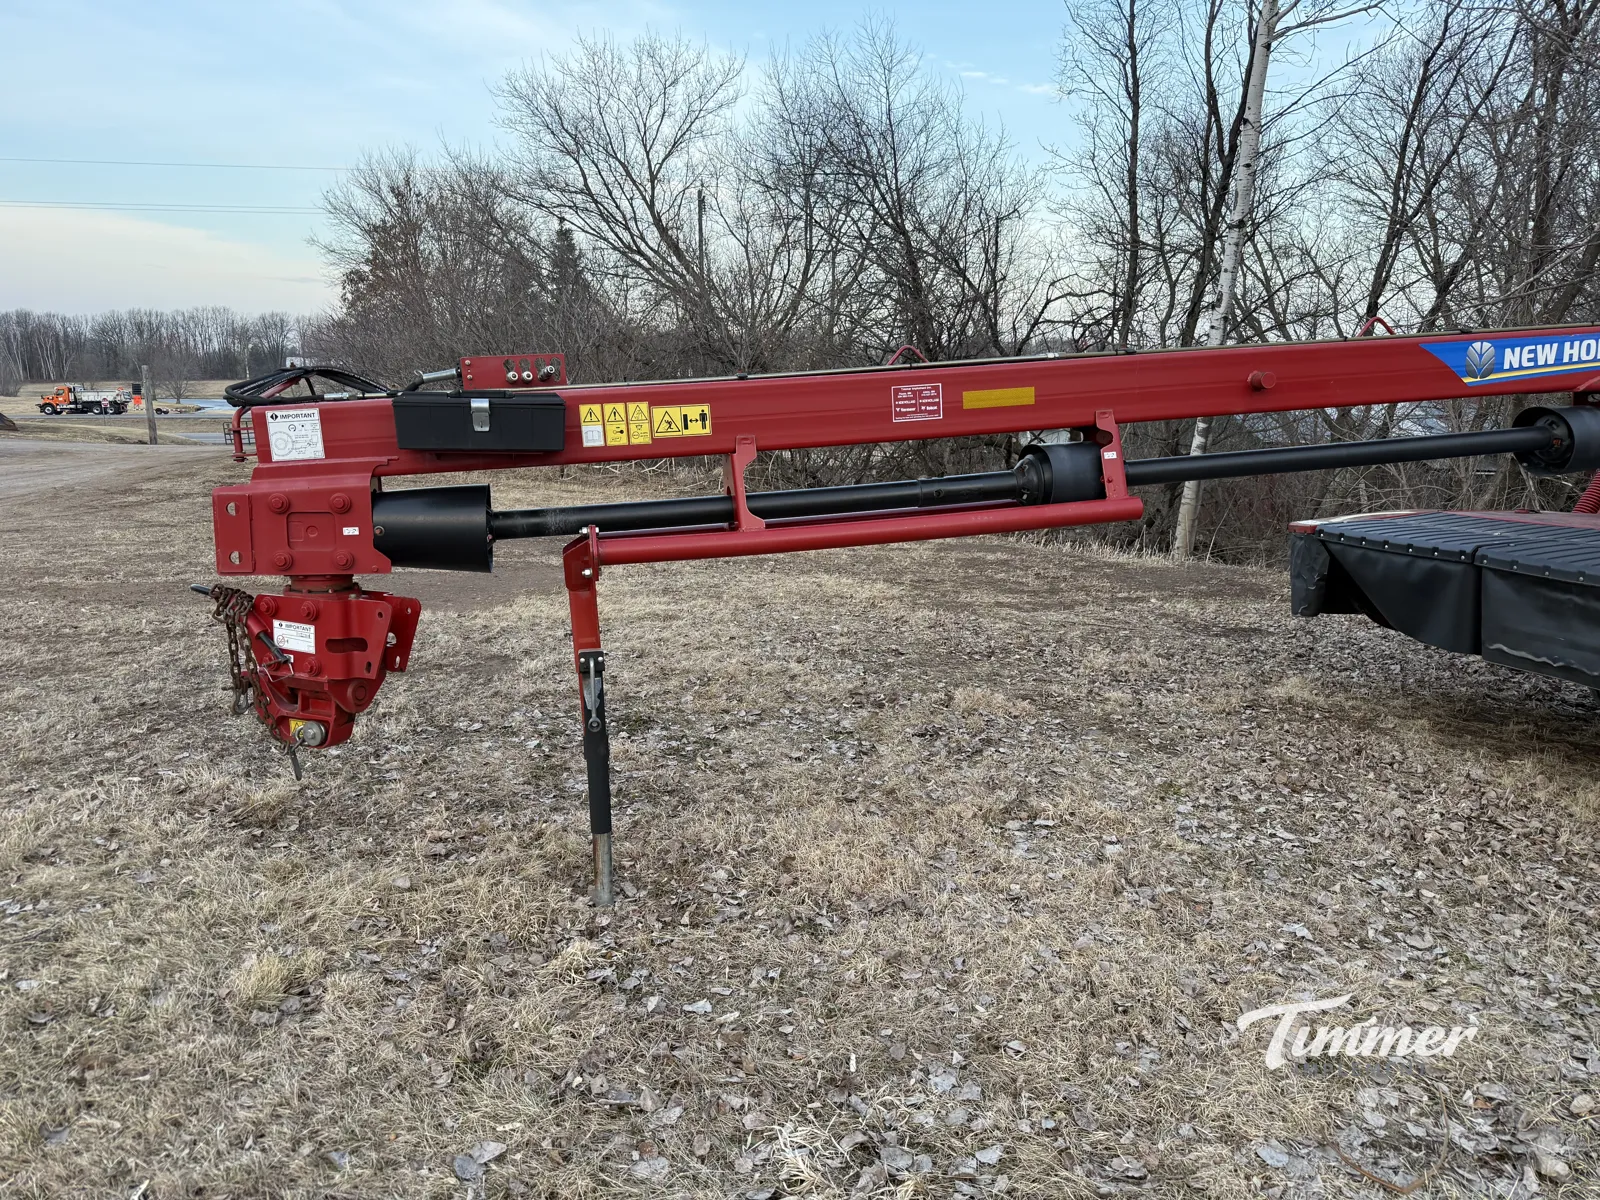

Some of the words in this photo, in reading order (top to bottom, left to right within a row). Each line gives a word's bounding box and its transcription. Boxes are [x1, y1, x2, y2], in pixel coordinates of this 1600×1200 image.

[1503, 343, 1558, 369] NEW
[1563, 338, 1600, 363] HO
[285, 624, 311, 632] IMPORTANT
